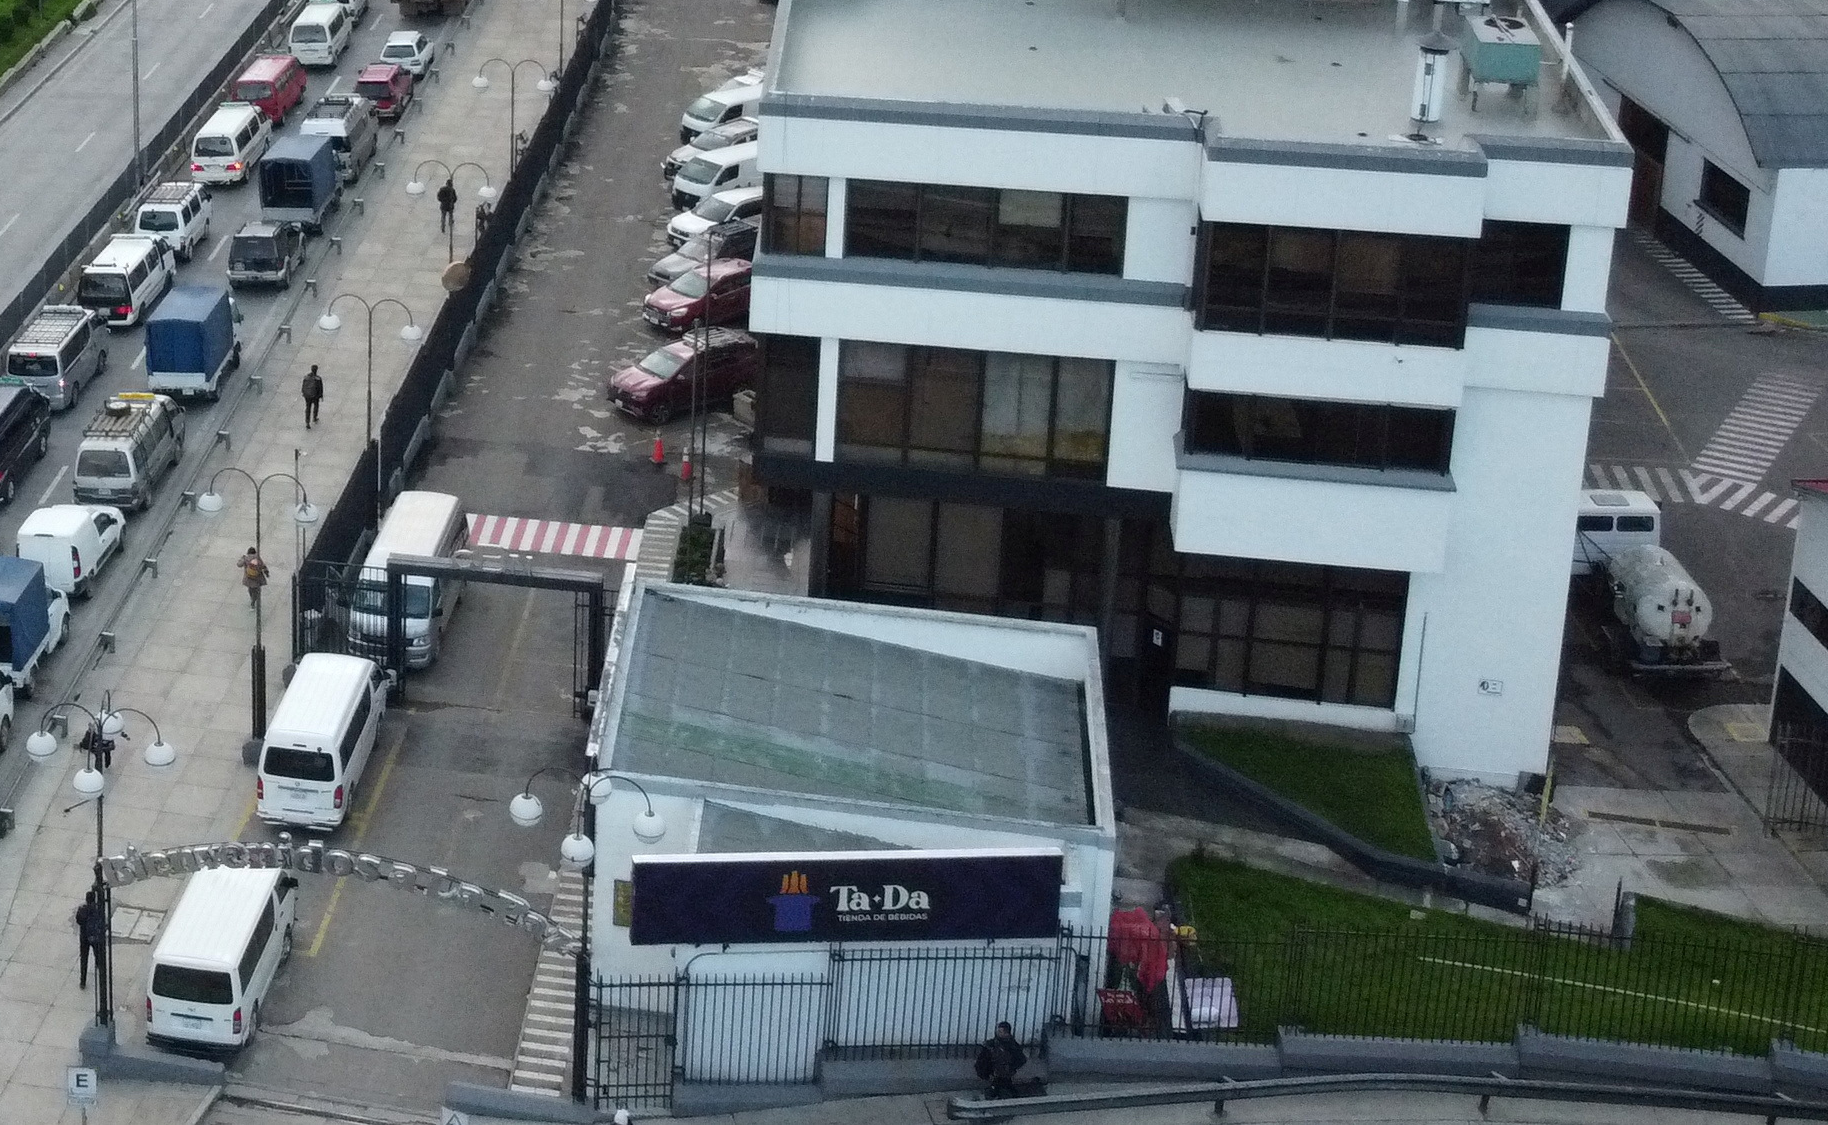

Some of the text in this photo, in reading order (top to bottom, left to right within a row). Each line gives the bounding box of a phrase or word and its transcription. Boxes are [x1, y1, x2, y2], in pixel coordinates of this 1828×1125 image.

[837, 914, 872, 922] TIENDA
[888, 913, 928, 921] BEBIDAS
[76, 1073, 88, 1088] E
